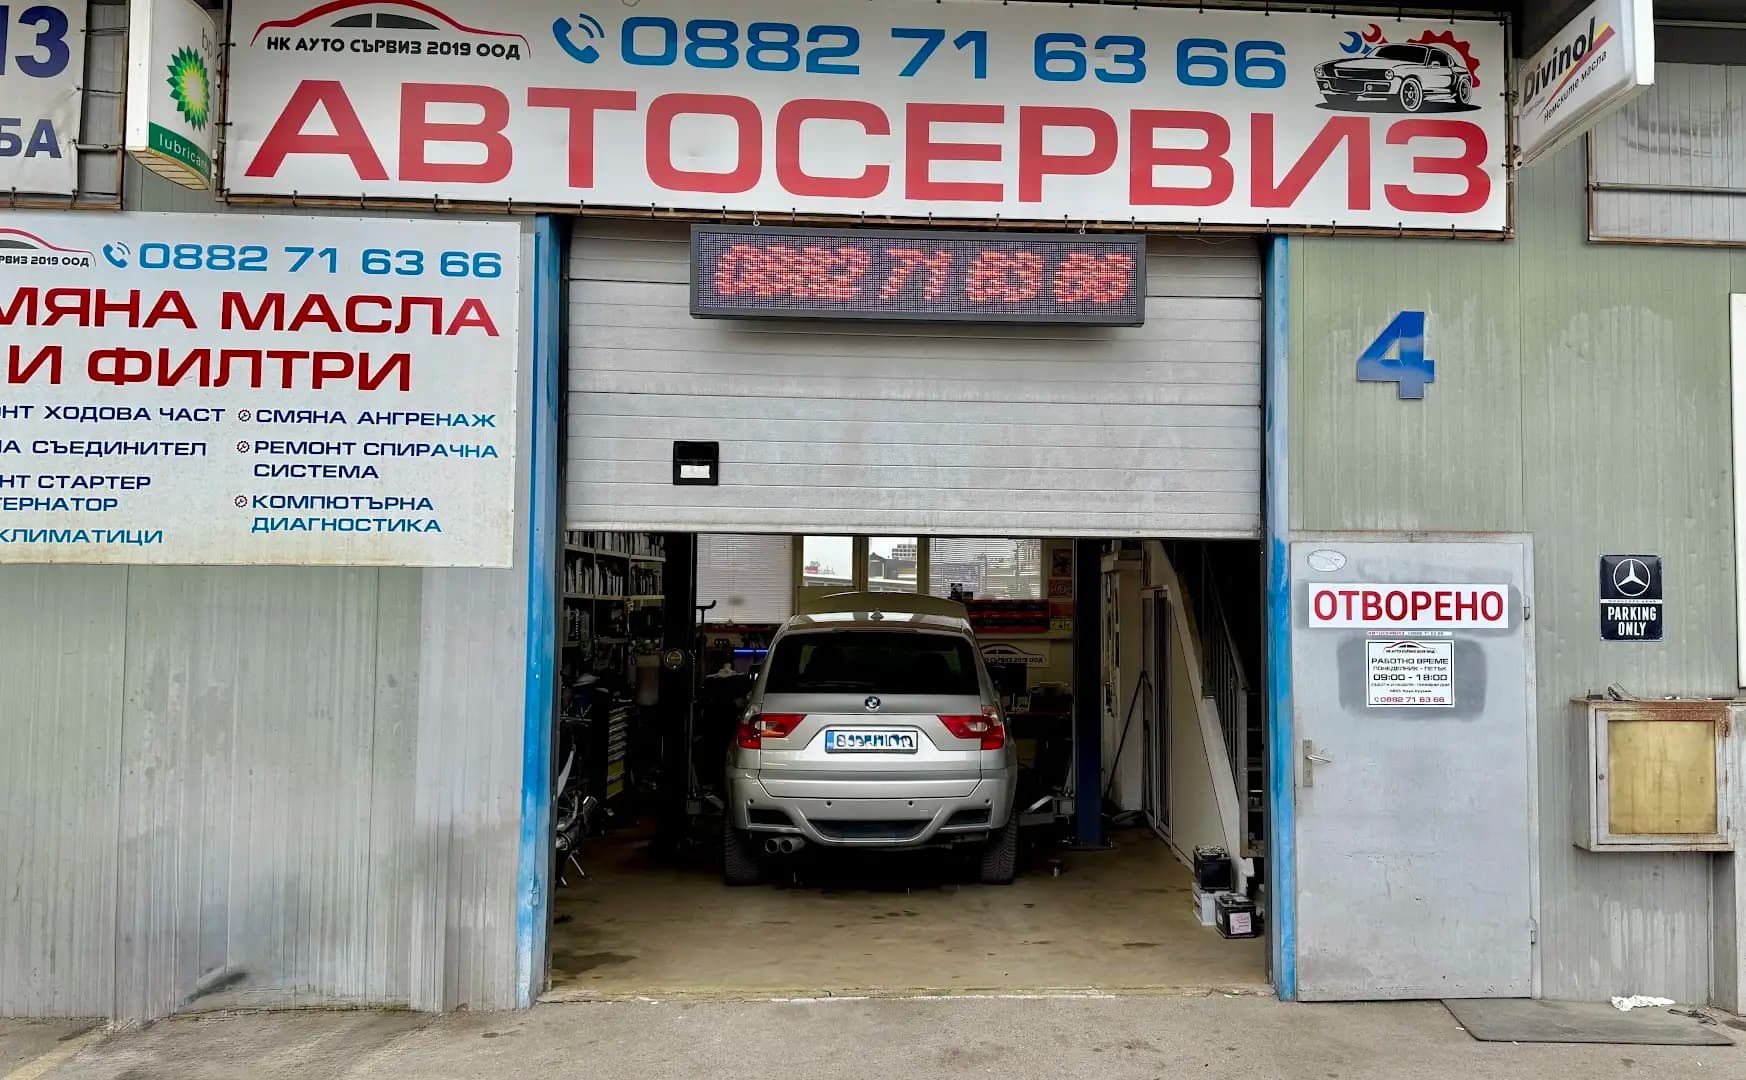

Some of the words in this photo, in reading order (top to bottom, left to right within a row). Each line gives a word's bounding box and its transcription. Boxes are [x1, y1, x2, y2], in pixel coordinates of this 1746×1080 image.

[0, 5, 69, 78] З
[267, 37, 290, 50] НК
[296, 38, 344, 52] АУТО
[350, 40, 422, 54] СЪРВИЗ
[427, 42, 470, 55] 2019
[477, 44, 520, 60] ООД
[622, 17, 860, 75] 0882
[891, 28, 987, 79] 71
[1035, 33, 1147, 83] 63
[1177, 38, 1286, 88] 66
[1523, 16, 1596, 107] Divinol
[160, 133, 208, 172] lubricant
[245, 80, 1490, 213] АВТОСЕРВИЗ
[31, 257, 58, 265] 2019
[62, 257, 89, 267] ООД
[139, 243, 267, 271] 0882
[284, 247, 337, 273] 71
[362, 249, 424, 275] 63
[440, 252, 502, 278] 66
[0, 287, 197, 328] МЯНА
[222, 292, 500, 336] МАСЛА
[1356, 311, 1434, 399] 4
[8, 345, 62, 384] И
[88, 347, 411, 391] ФИЛТРИ
[0, 405, 34, 418] НТ
[44, 406, 151, 422] ХОДОВА
[160, 408, 226, 421] ЧАСТ
[256, 410, 347, 424] СМЯНА
[357, 412, 496, 427] АНГРЕНАЖ
[0, 440, 21, 453] А
[33, 441, 206, 457] СЪЕДИНИТЕЛ
[255, 441, 357, 456] РЕМОНТ
[364, 443, 498, 458] СПИРАЧНА
[254, 464, 379, 478] СИСТЕМА
[38, 476, 151, 489] СТАРТЕР
[0, 497, 118, 511] ЕРНАТОР
[252, 495, 434, 510] КОМПЮТЪРНА
[252, 518, 442, 533] ДИАГНОСТИКА
[0, 529, 163, 546] КЛИМАТИЦИ
[1315, 590, 1503, 621] ОТВОРЕНО
[1608, 606, 1656, 620] PARKING
[1618, 621, 1646, 636] ONLY
